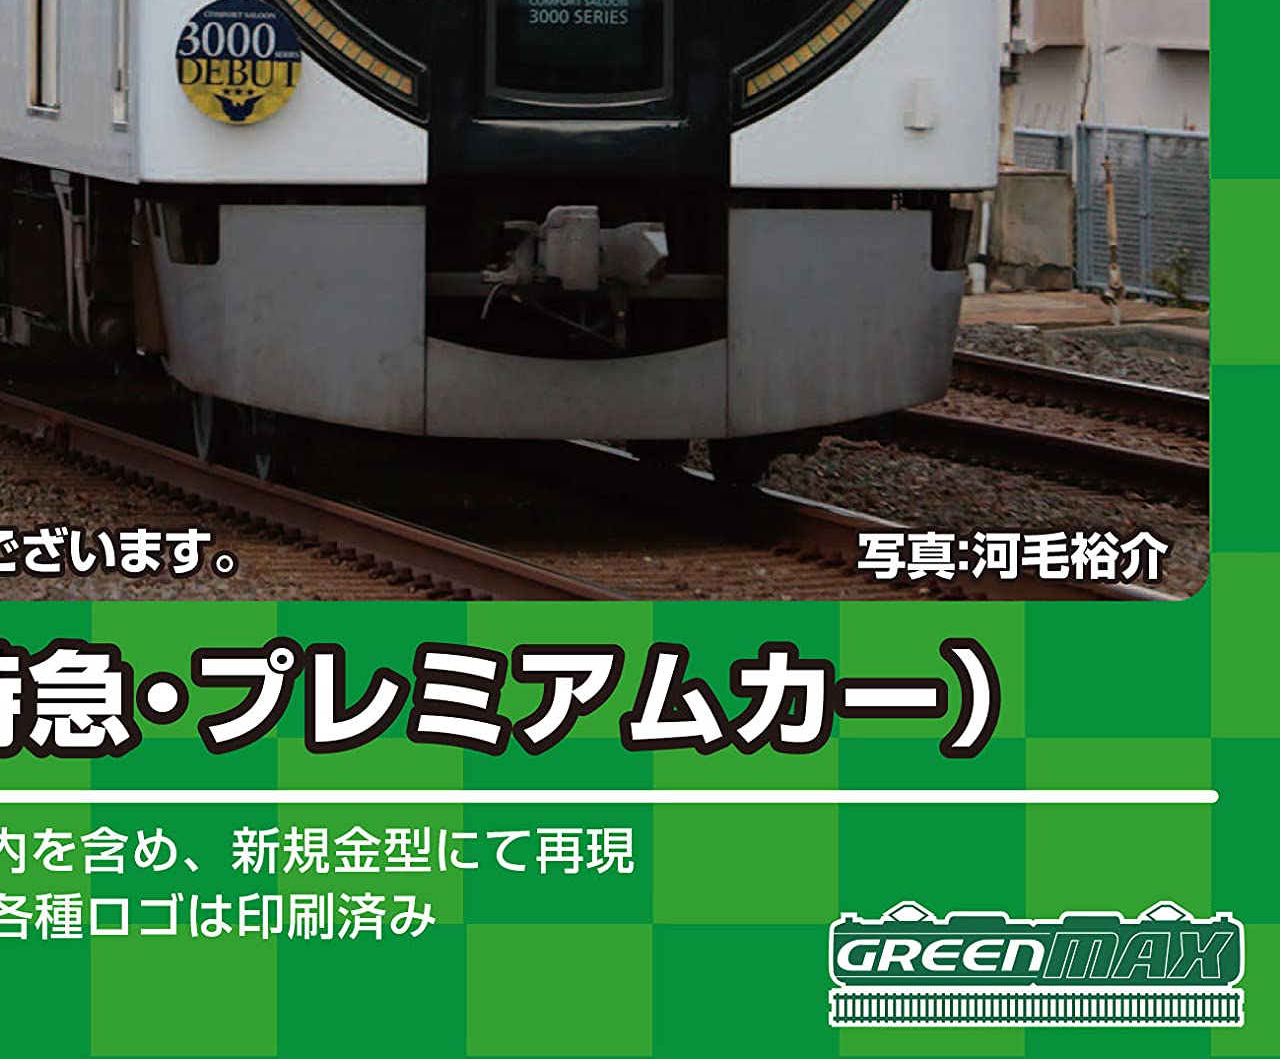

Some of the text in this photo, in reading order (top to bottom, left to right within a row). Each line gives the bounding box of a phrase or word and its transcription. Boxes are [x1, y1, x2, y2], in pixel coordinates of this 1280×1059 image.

[529, 9, 628, 24] 3000 SERIES
[179, 21, 276, 59] 3000
[177, 58, 297, 88] DEBUT
[836, 931, 1234, 979] GREENMAX
